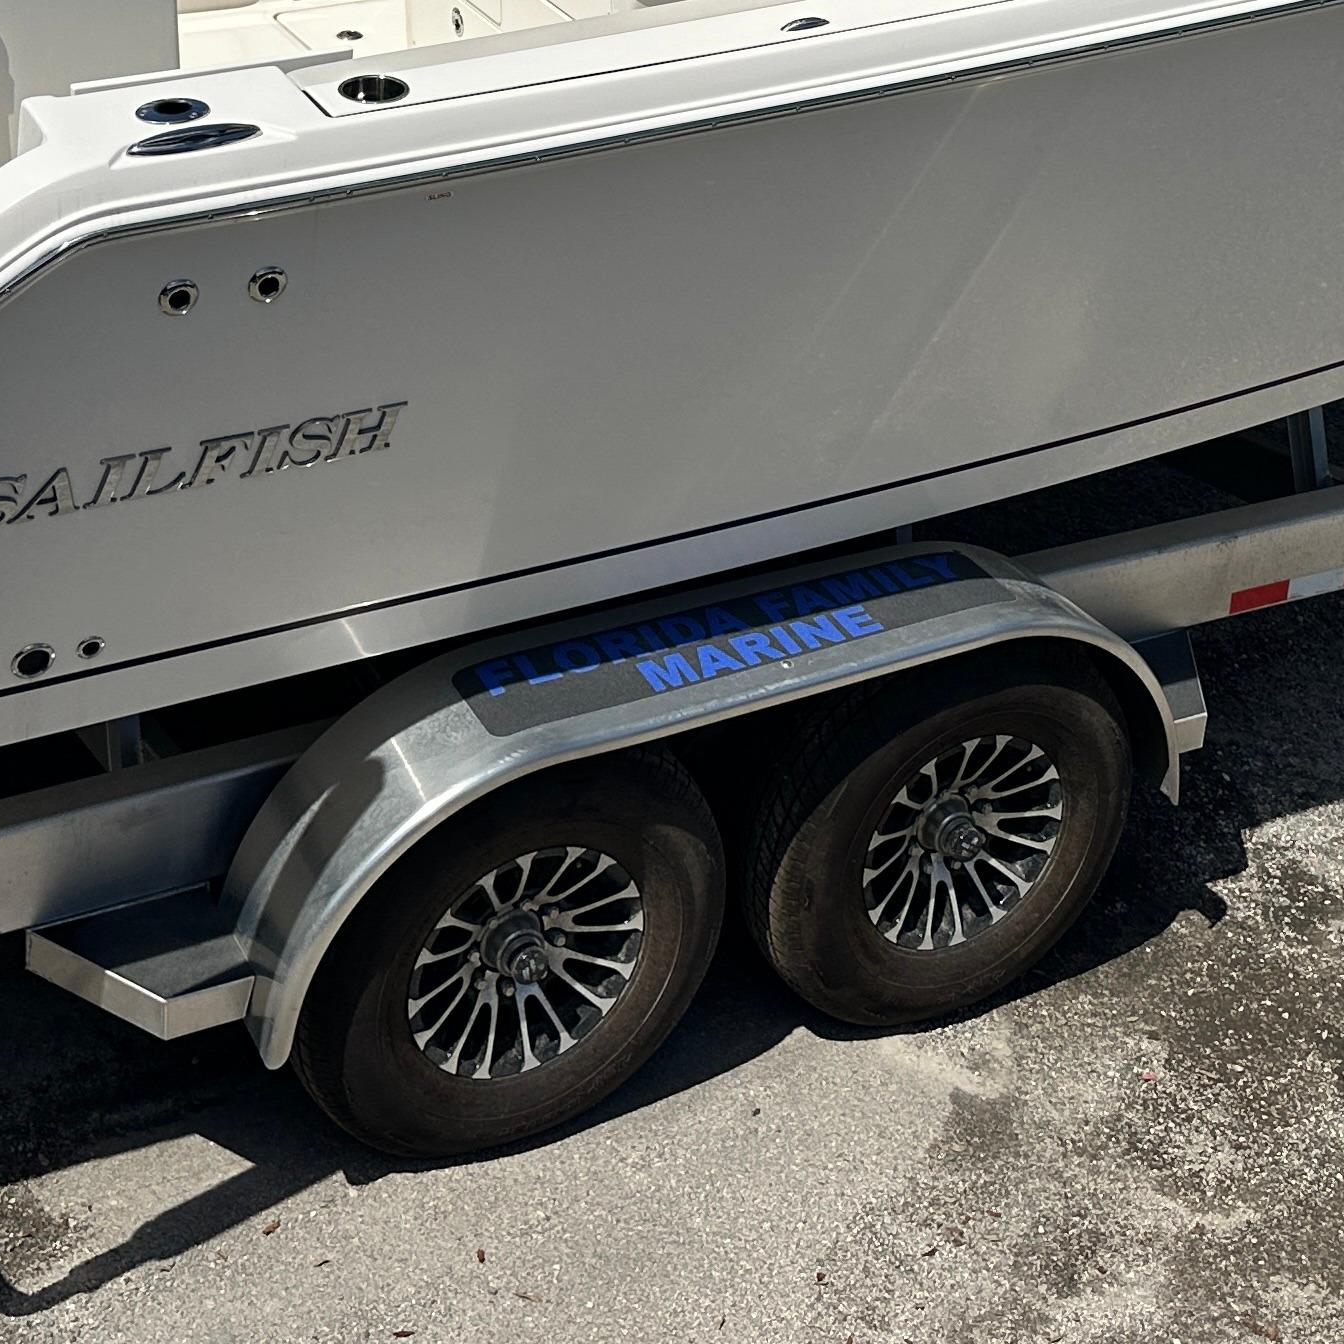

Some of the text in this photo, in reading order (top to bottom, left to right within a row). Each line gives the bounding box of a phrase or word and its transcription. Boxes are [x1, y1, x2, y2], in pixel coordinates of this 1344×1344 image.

[473, 553, 957, 697] FLORIDA FAMILY
[635, 603, 885, 693] MARINE
